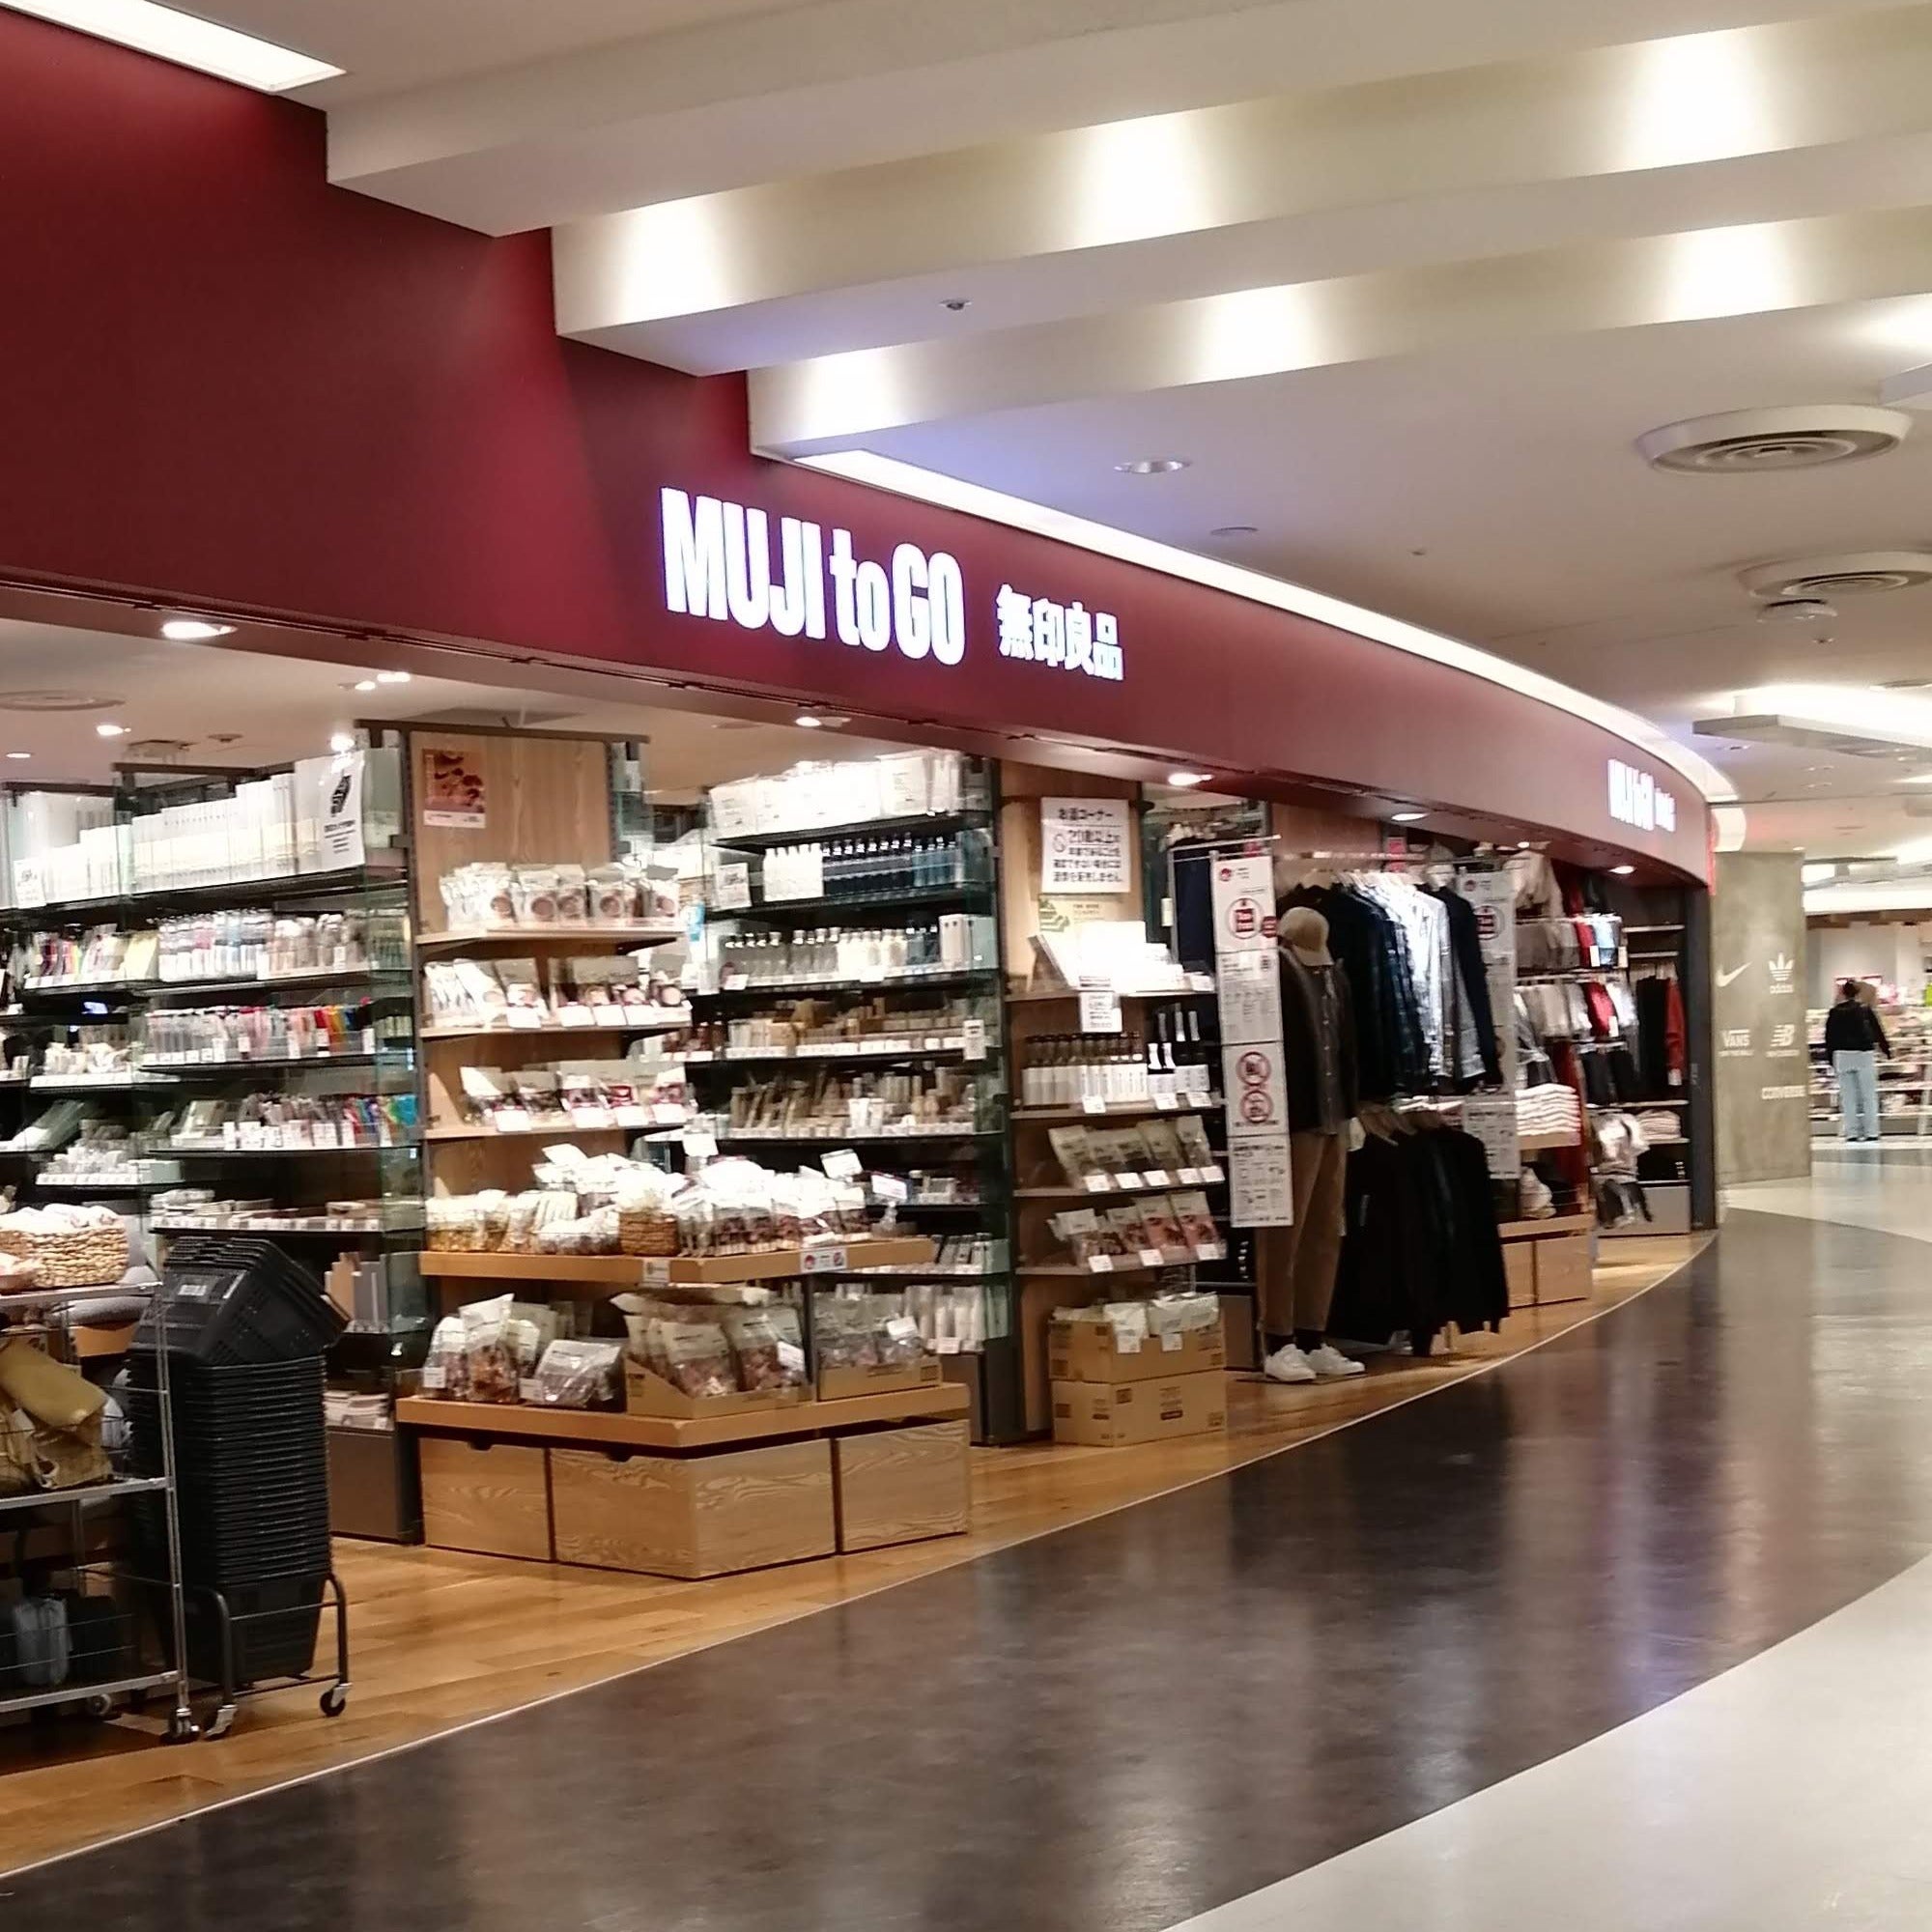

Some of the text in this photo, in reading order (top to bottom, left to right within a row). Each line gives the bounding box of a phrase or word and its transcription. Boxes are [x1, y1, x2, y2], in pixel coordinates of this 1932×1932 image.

[661, 486, 827, 641] MUJI
[996, 583, 1124, 681] 無印良品
[1721, 1029, 1750, 1047] VANS
